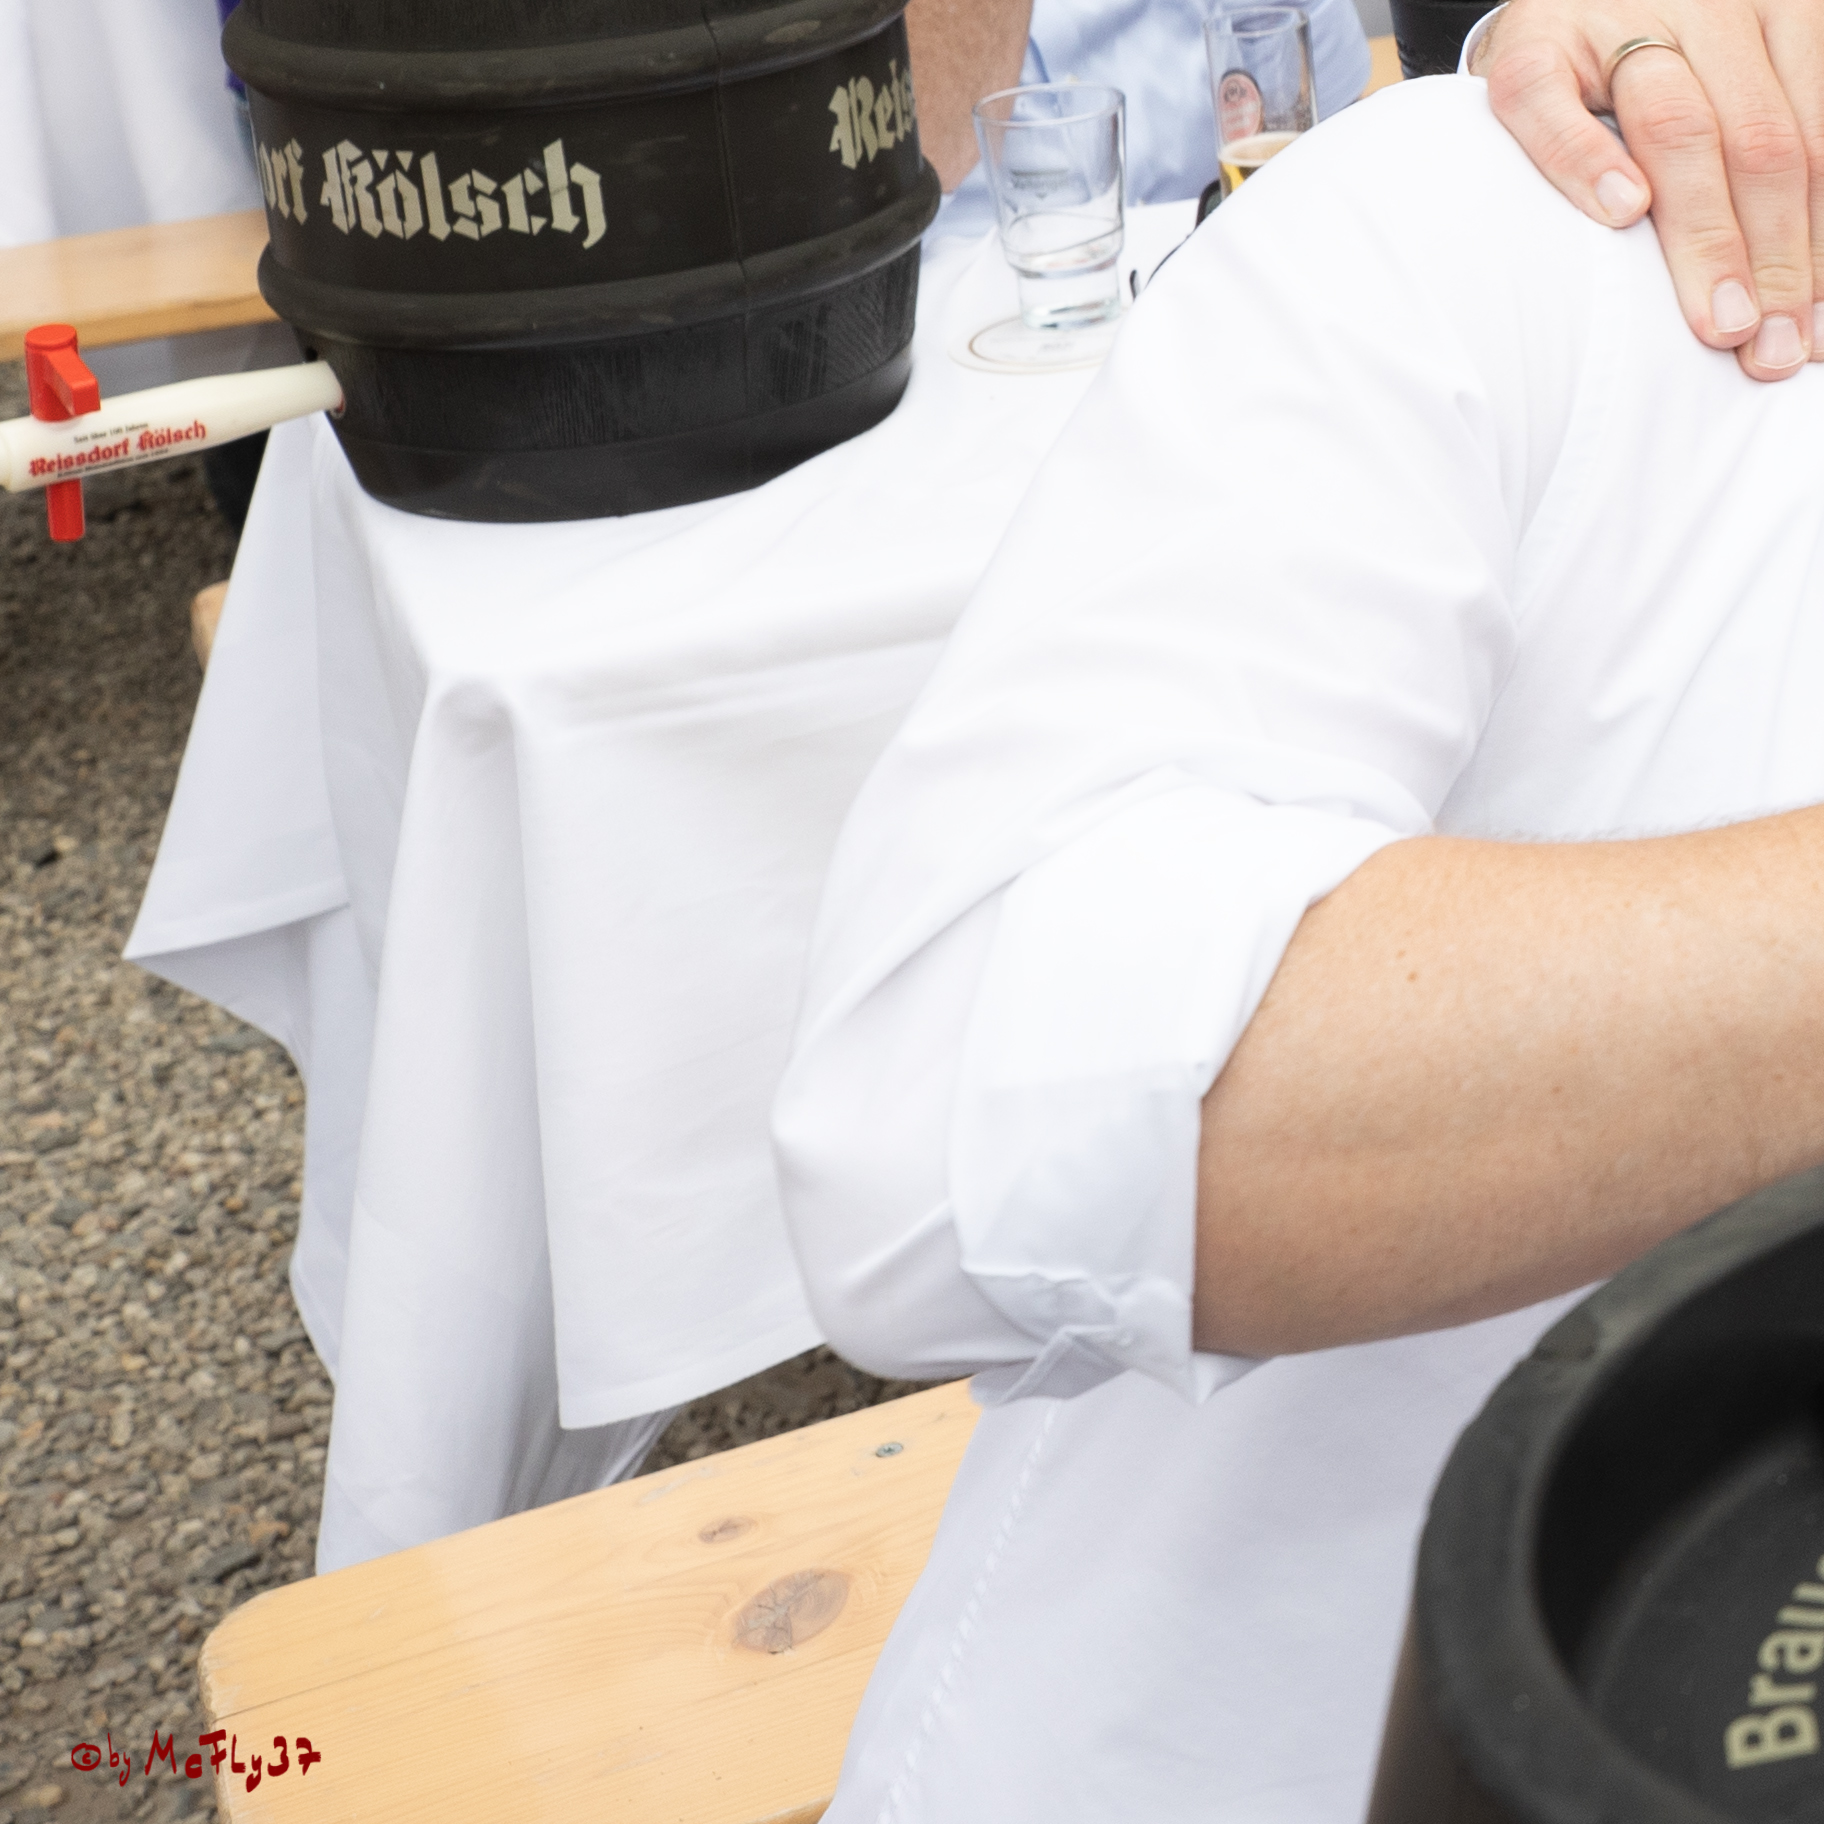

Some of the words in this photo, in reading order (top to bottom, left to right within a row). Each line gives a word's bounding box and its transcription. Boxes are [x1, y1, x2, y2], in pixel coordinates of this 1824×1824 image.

[320, 138, 607, 249] Kölsch
[29, 438, 130, 476] Reissdorf
[136, 420, 207, 453] Kölsch
